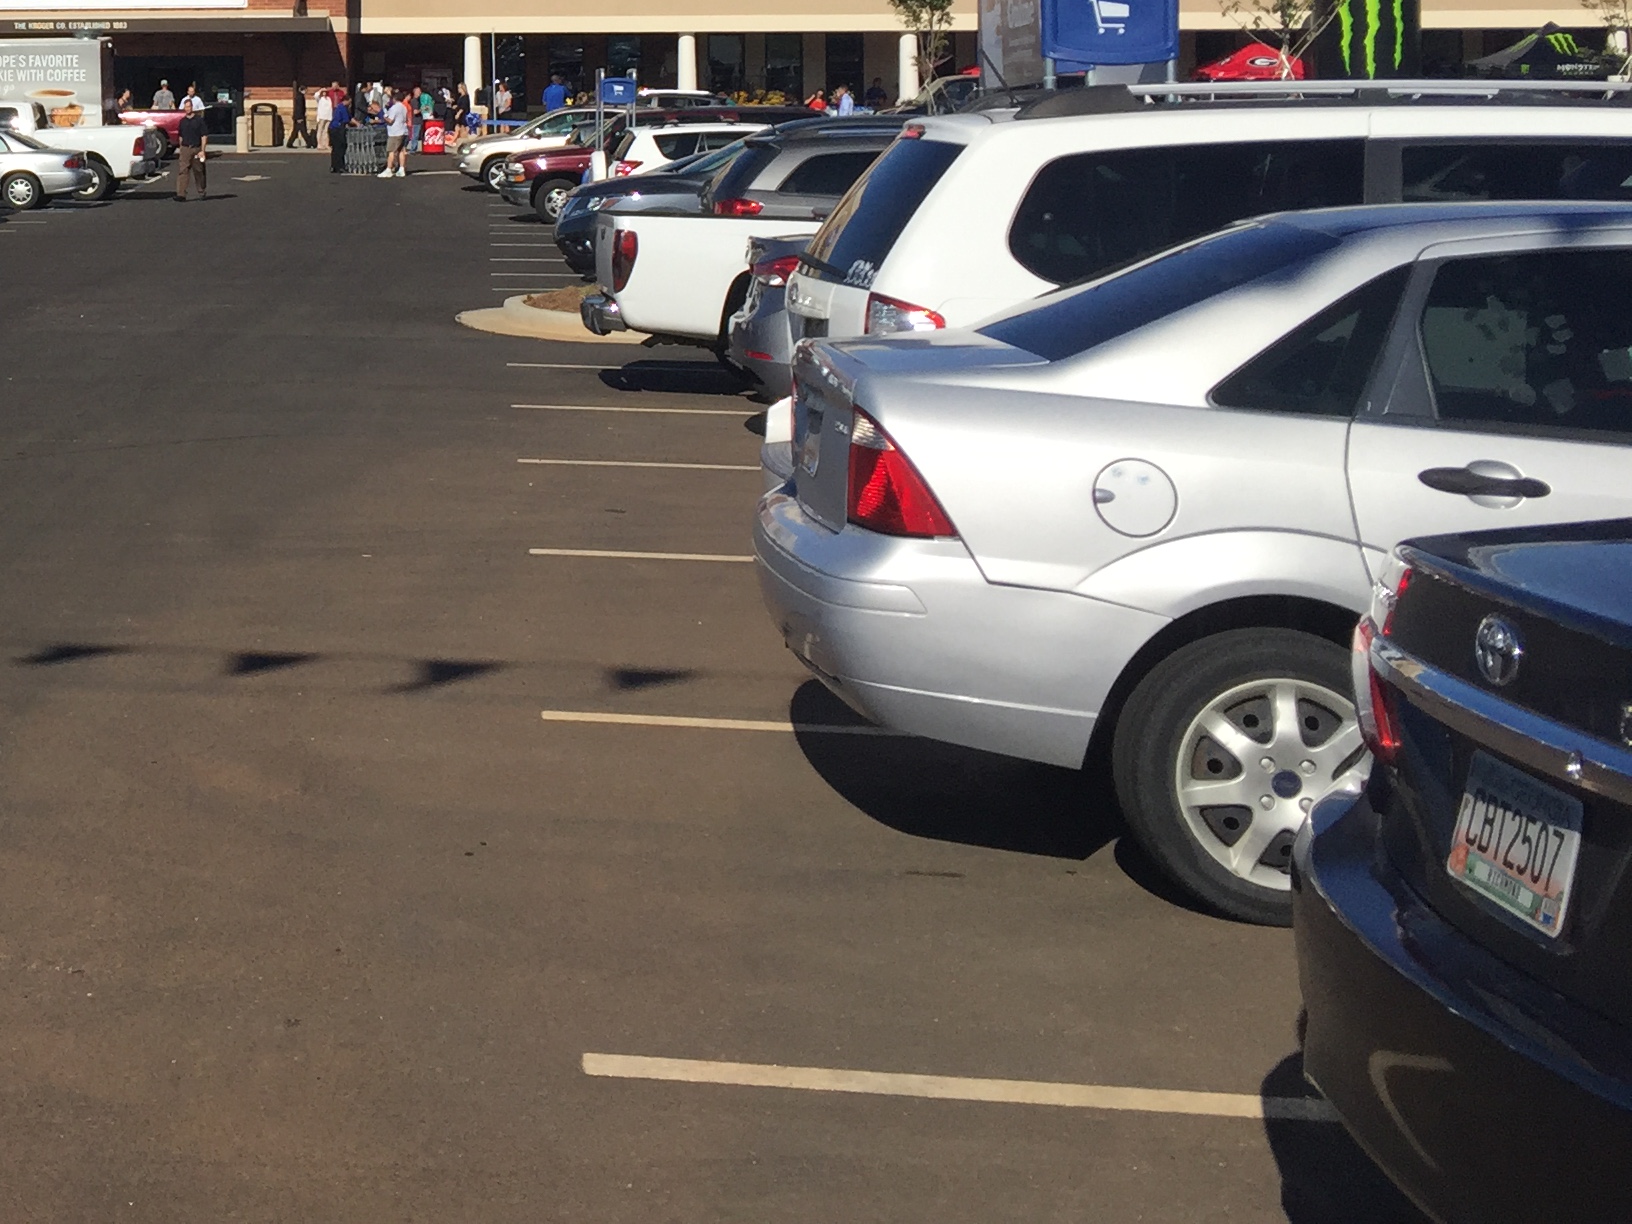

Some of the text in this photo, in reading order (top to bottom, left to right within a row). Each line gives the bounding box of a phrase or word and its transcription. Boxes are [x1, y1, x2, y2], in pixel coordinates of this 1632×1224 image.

[28, 54, 79, 68] FAVORITE
[16, 69, 44, 82] WITH
[47, 69, 86, 82] COFFEE
[1465, 788, 1565, 892] CBT2507
